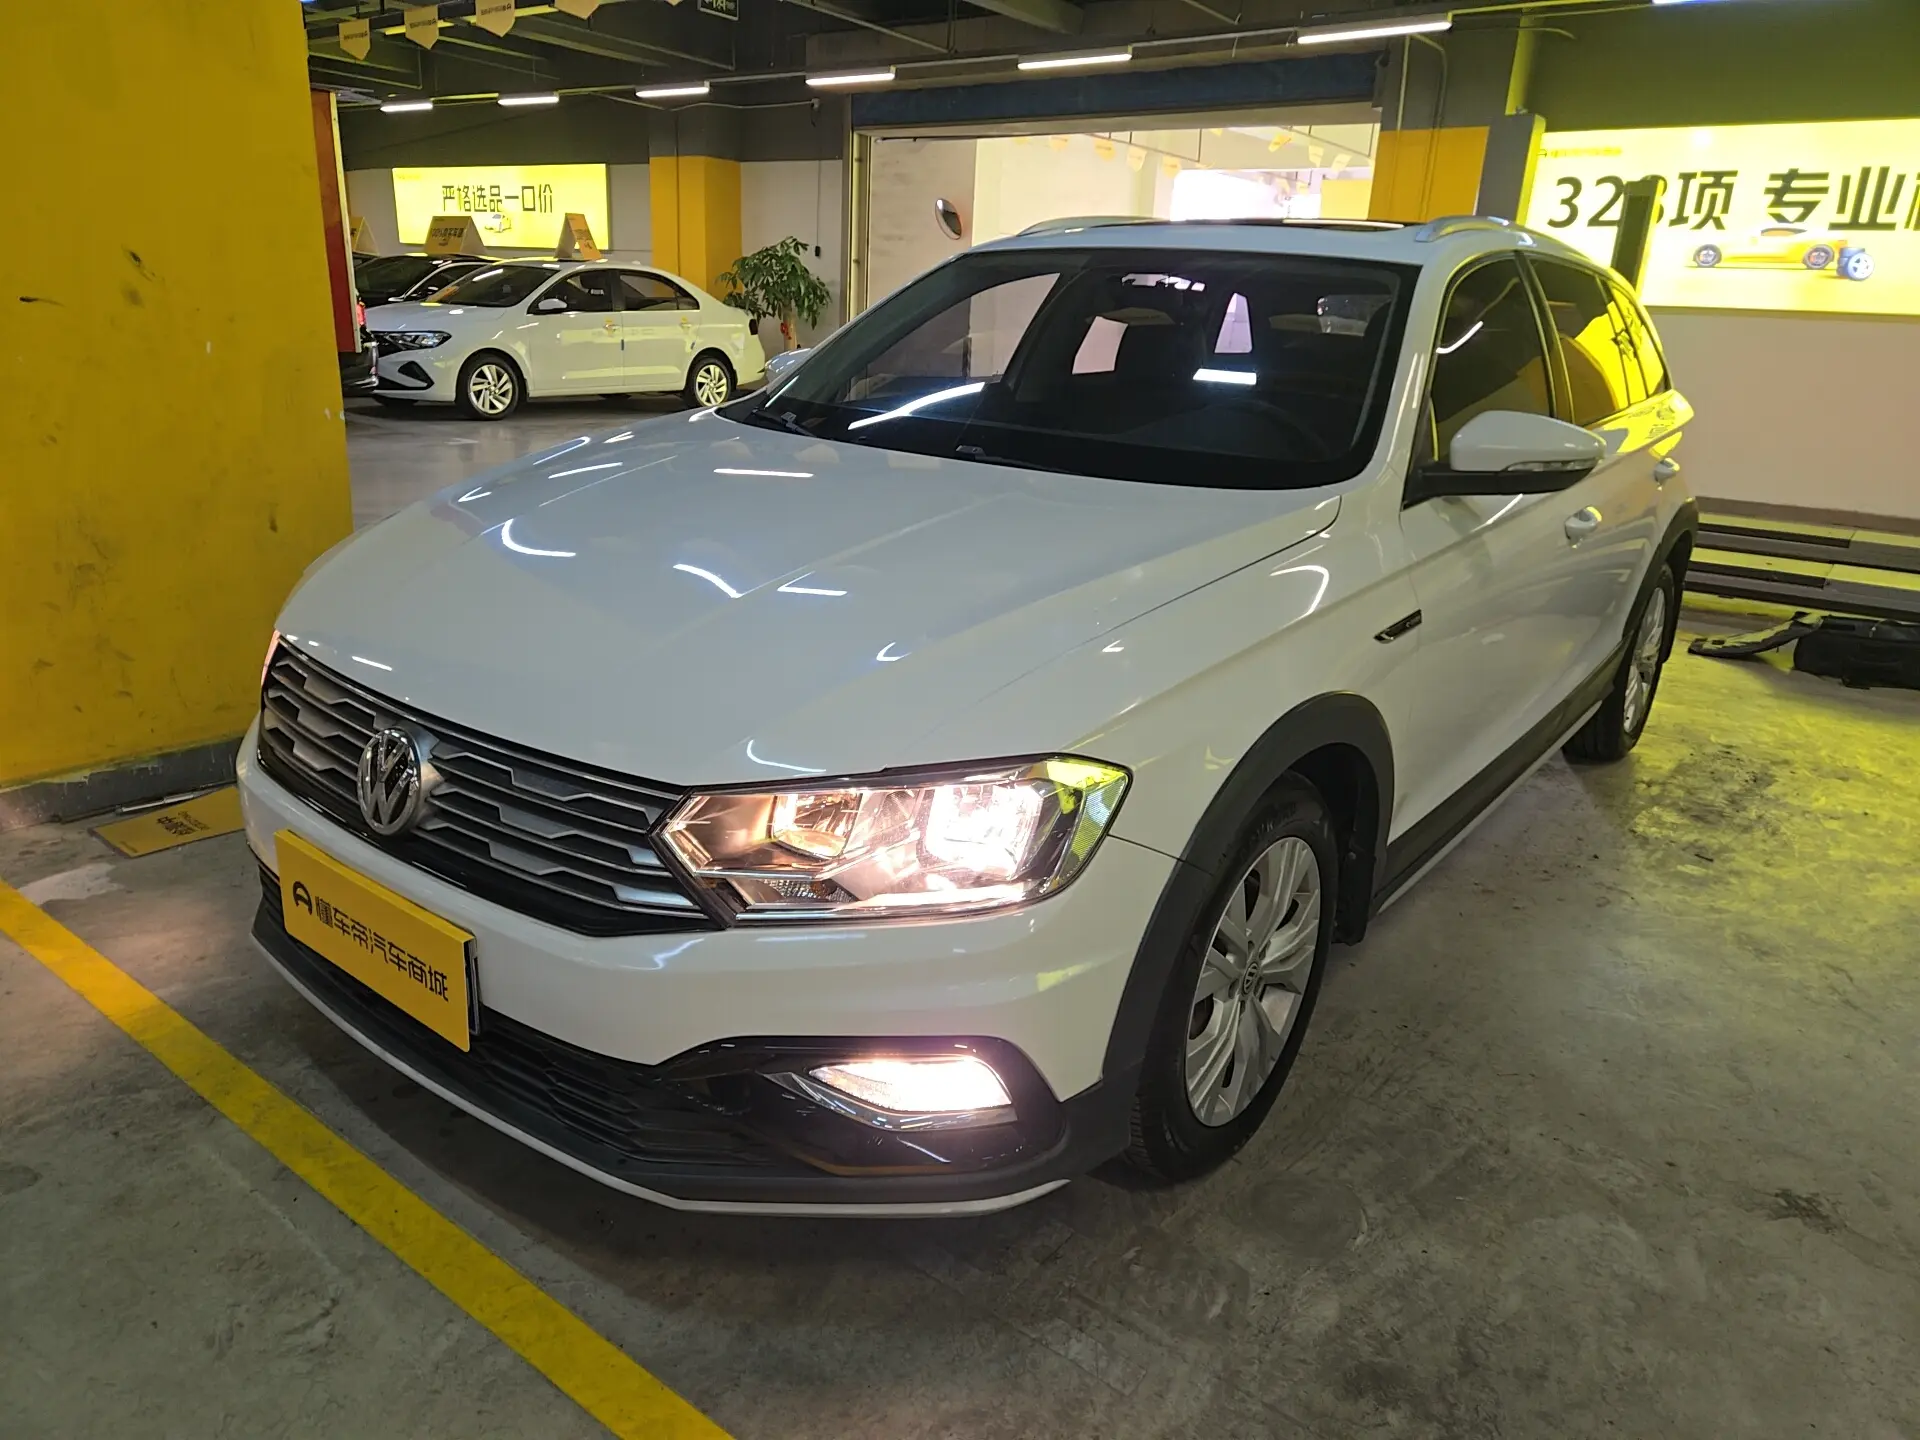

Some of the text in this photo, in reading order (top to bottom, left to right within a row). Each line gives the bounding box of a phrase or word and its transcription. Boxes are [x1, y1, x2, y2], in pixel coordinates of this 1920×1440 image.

[441, 184, 553, 213] 严格选品一口价
[314, 895, 449, 1002] 懂车帝汽车商城
